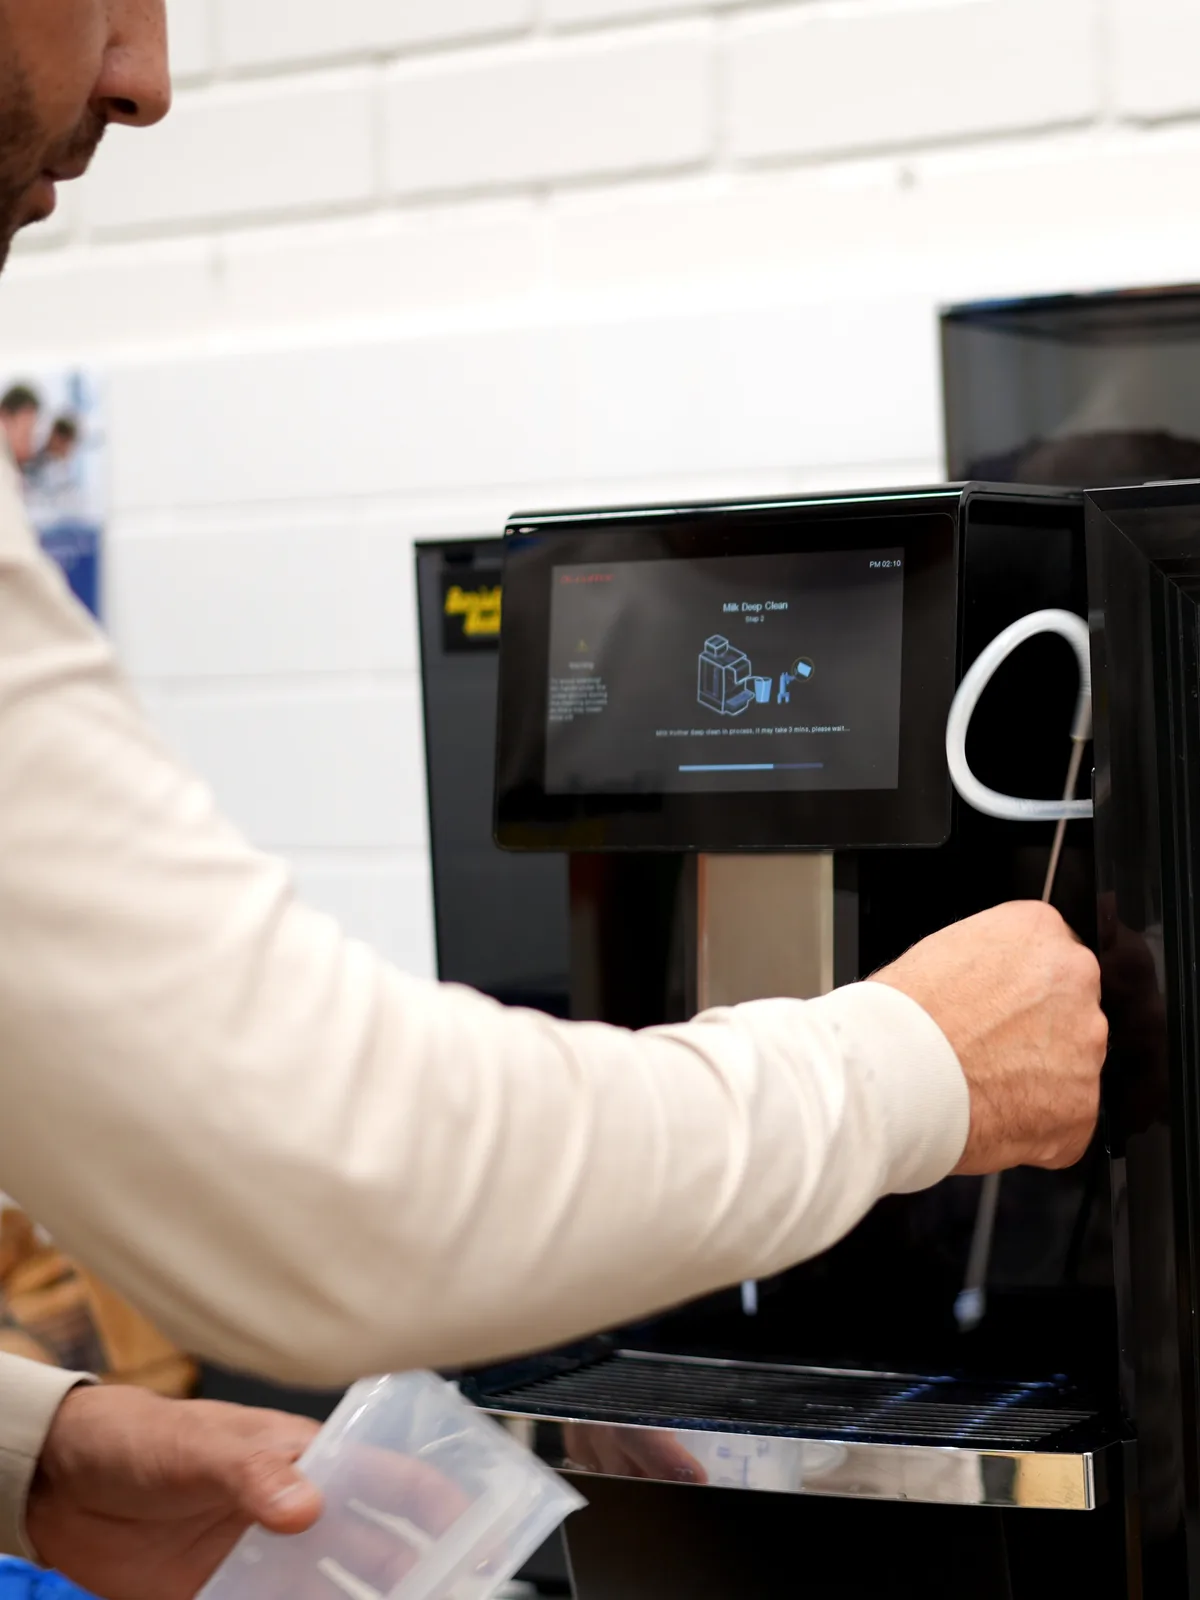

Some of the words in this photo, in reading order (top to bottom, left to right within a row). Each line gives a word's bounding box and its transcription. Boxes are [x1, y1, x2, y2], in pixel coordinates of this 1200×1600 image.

[869, 560, 881, 568] PM
[882, 559, 902, 568] 02:10
[723, 602, 739, 613] Milk
[741, 601, 763, 613] Deep
[764, 600, 788, 611] Clean
[811, 725, 832, 734] please
